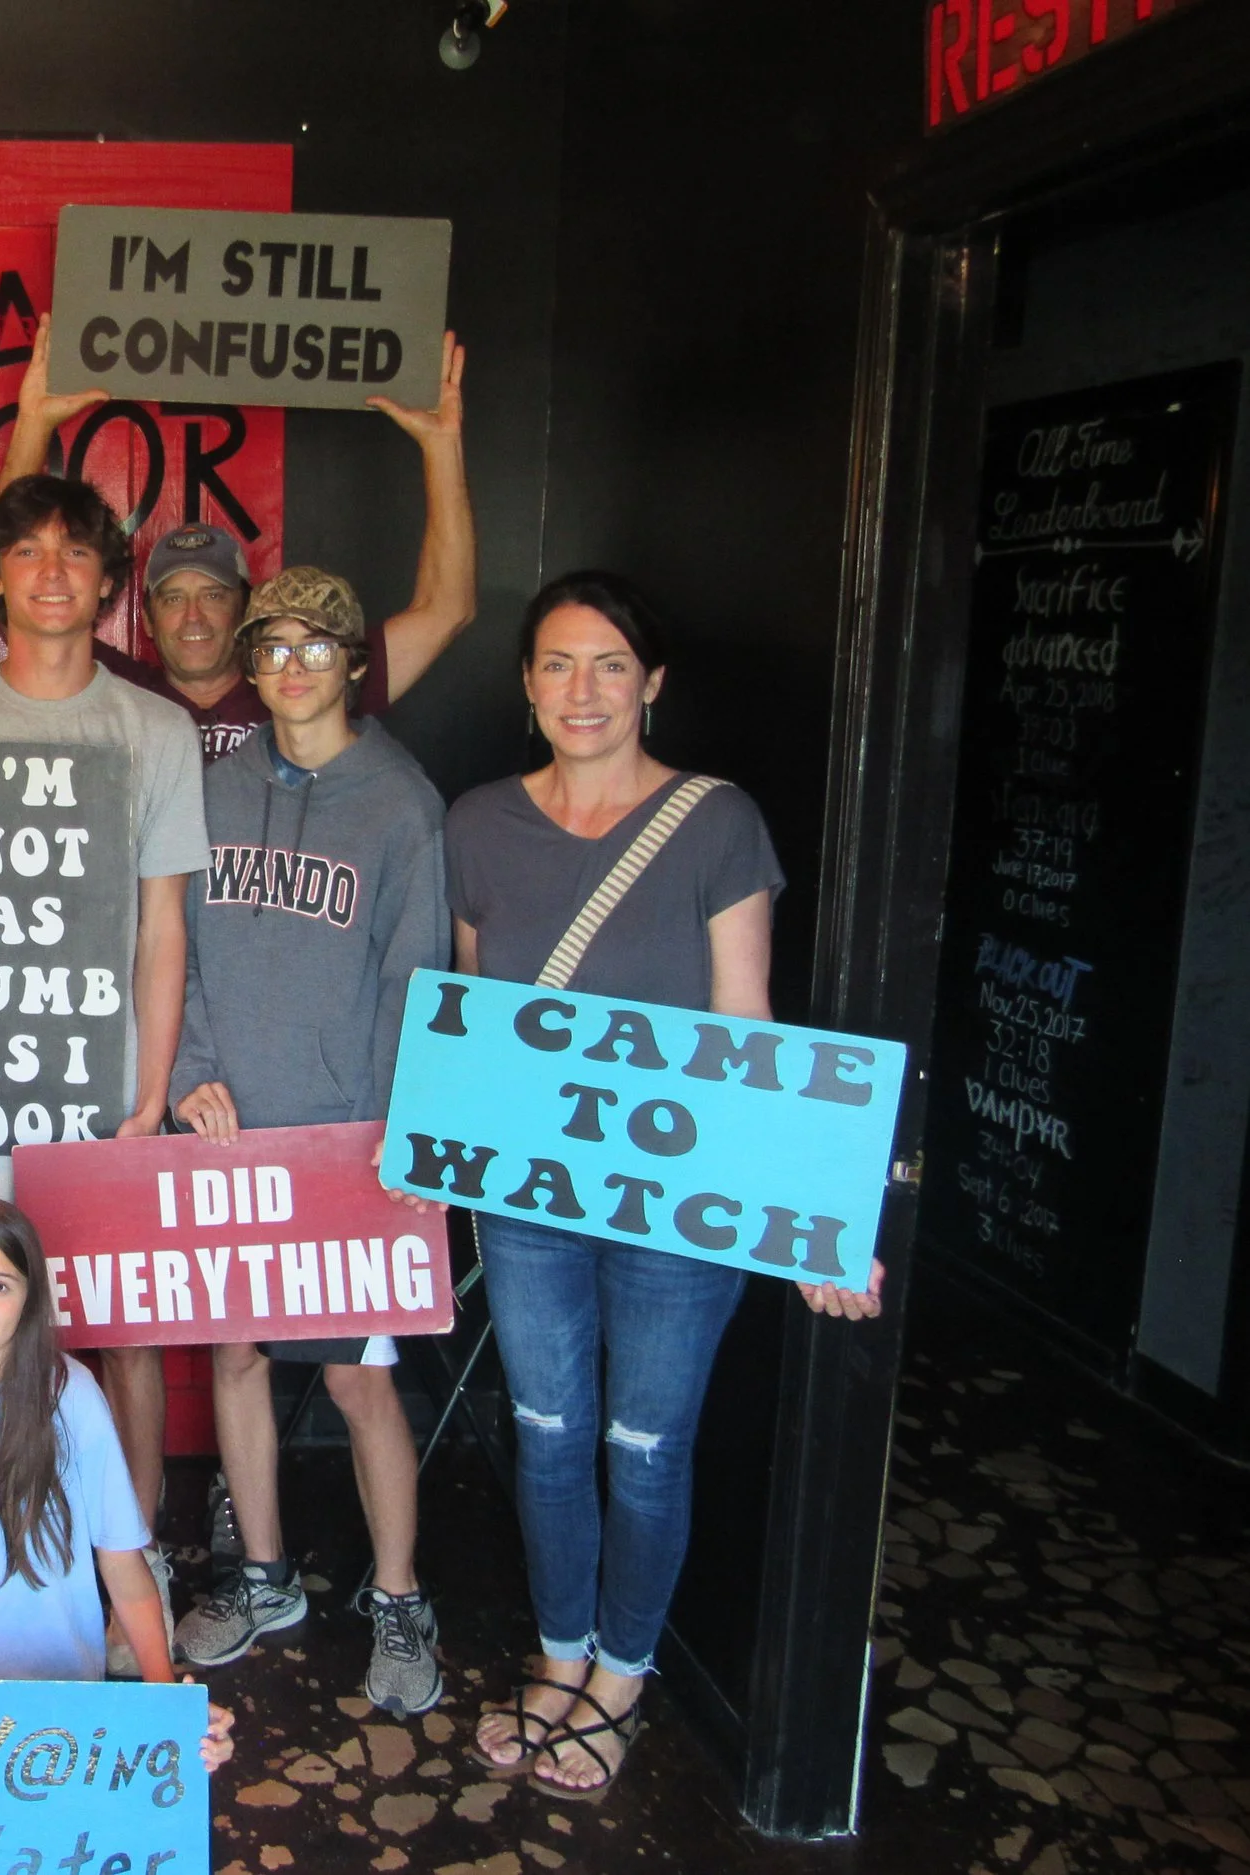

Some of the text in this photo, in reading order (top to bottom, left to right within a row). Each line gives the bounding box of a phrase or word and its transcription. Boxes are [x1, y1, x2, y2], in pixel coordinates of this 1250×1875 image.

[109, 234, 381, 301] I'M STILL
[80, 315, 403, 383] CONFUSED
[1017, 417, 1136, 478] All Time
[206, 846, 357, 929] WANDO
[1018, 892, 1071, 928] Clues
[64, 1036, 89, 1084] I
[427, 983, 876, 1107] I CAME
[986, 1019, 1050, 1073] 32:18
[999, 1062, 1050, 1104] Clues
[559, 1082, 697, 1157] TO
[158, 1166, 293, 1228] I DID
[404, 1133, 848, 1278] WATCH
[978, 1212, 992, 1242] 3
[46, 1234, 434, 1328] EVERYTHING
